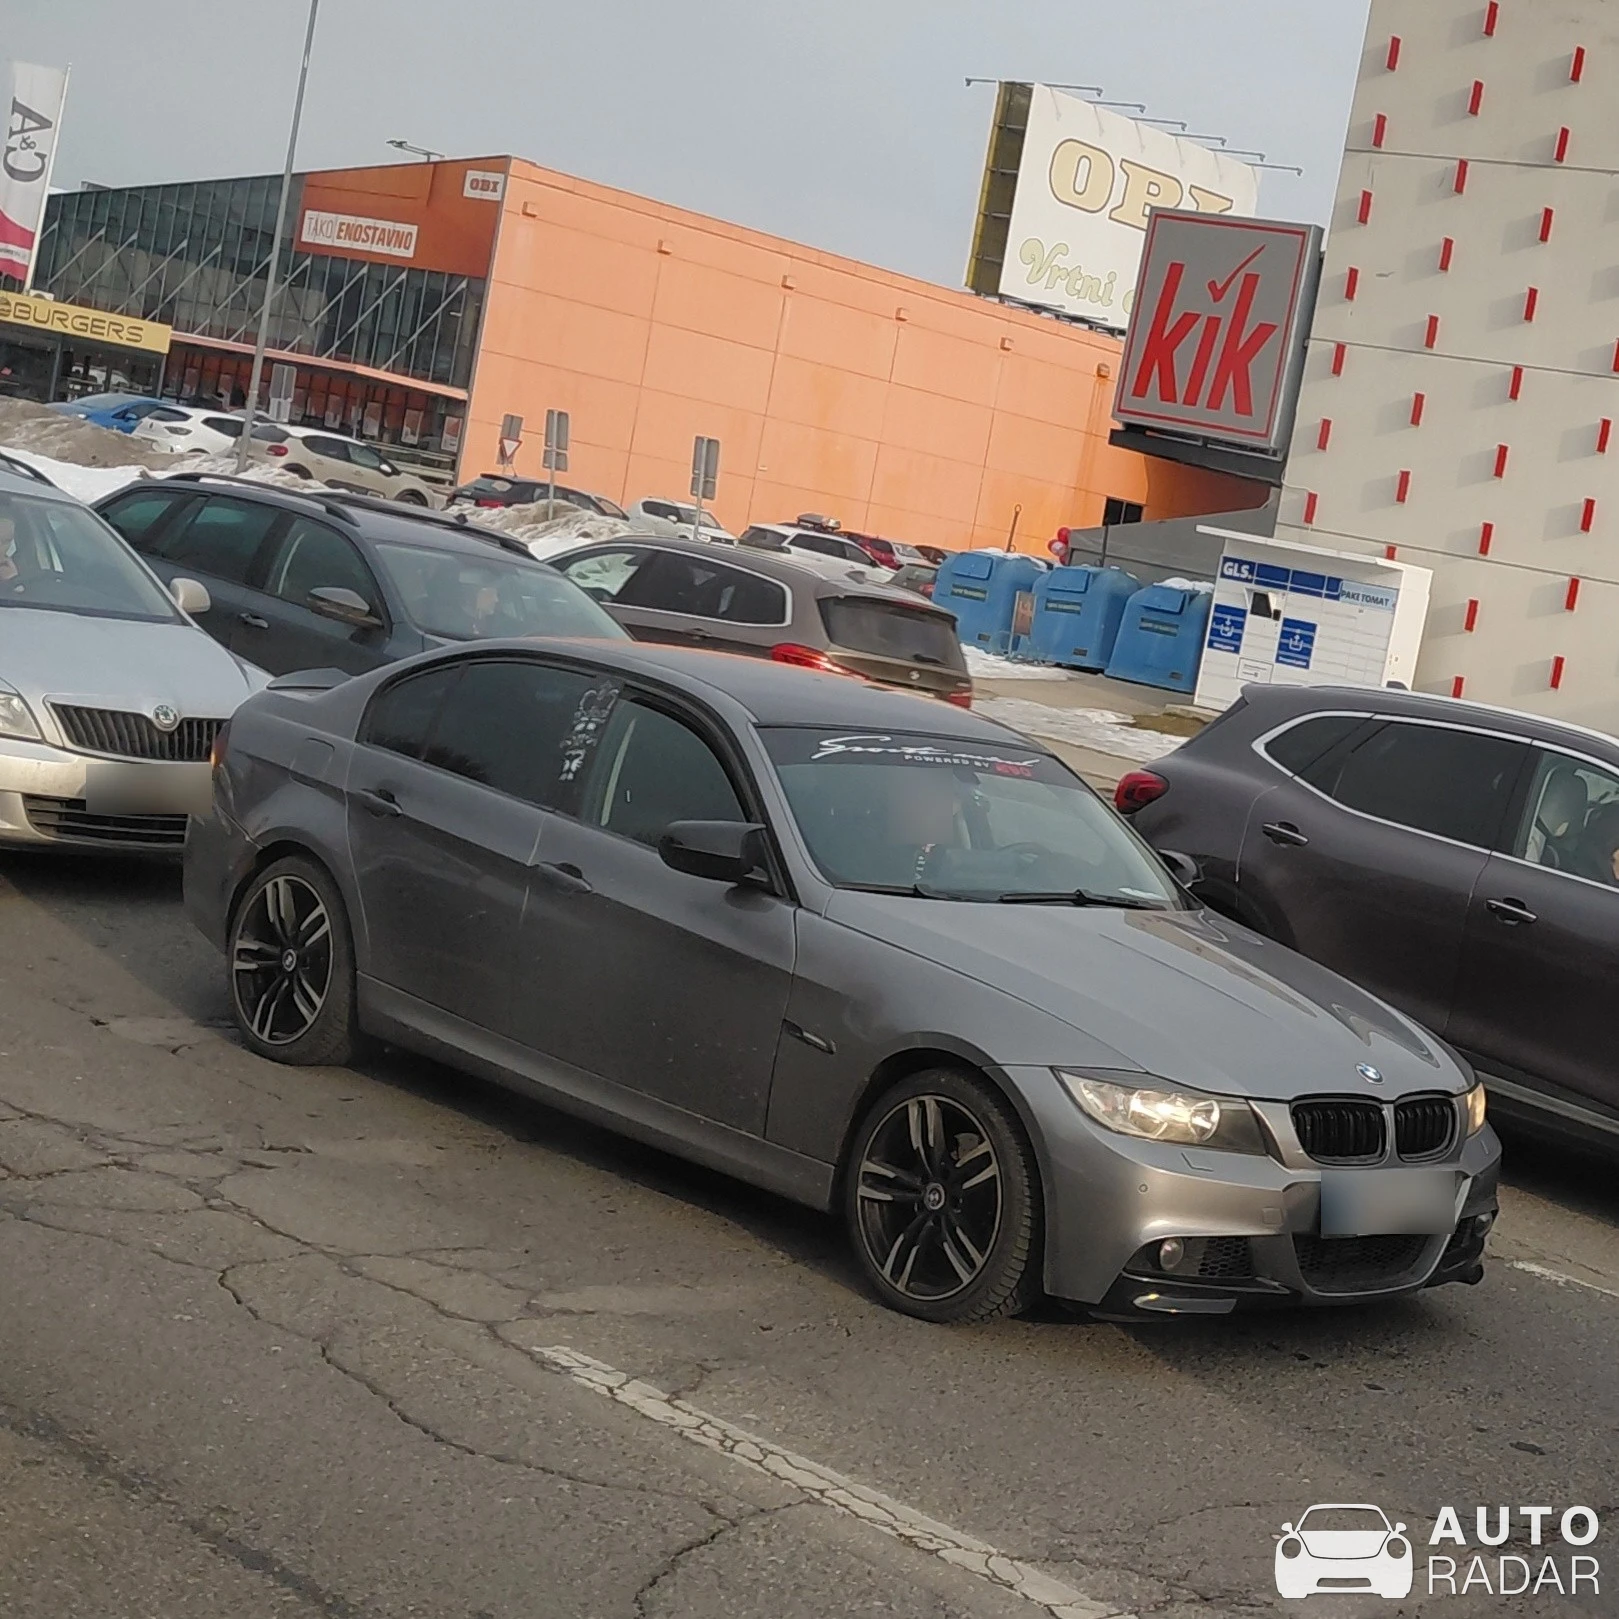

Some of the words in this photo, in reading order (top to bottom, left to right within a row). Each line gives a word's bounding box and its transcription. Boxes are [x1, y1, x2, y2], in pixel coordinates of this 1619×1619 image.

[3, 96, 53, 182] C&A
[469, 177, 501, 193] OBI
[306, 216, 334, 238] TAKO
[336, 220, 414, 250] ENOSTAVNO
[1019, 237, 1118, 307] Vrtni
[13, 301, 144, 343] BURGERS
[903, 753, 970, 766] POWERED
